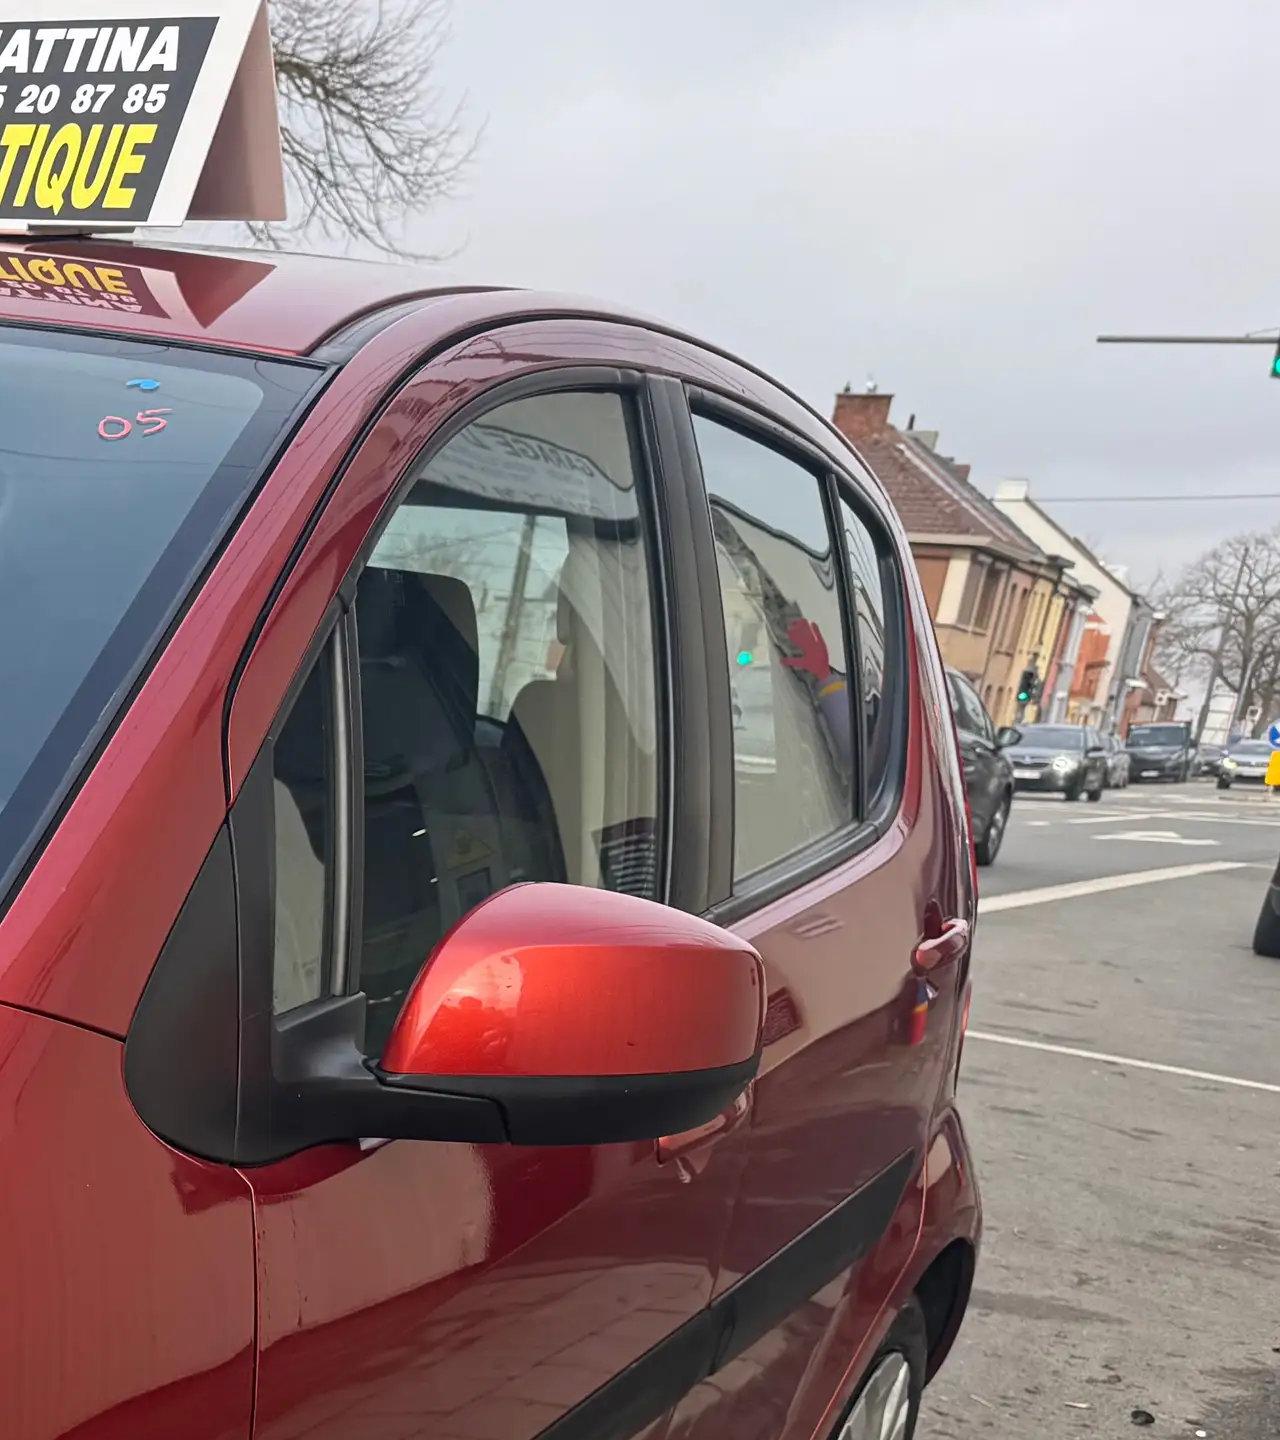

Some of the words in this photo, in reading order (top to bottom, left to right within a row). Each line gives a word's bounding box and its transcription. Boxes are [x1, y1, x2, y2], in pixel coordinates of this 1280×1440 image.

[14, 84, 61, 114] 20
[70, 83, 116, 114] 87
[122, 83, 170, 114] 85
[98, 408, 173, 440] 05
